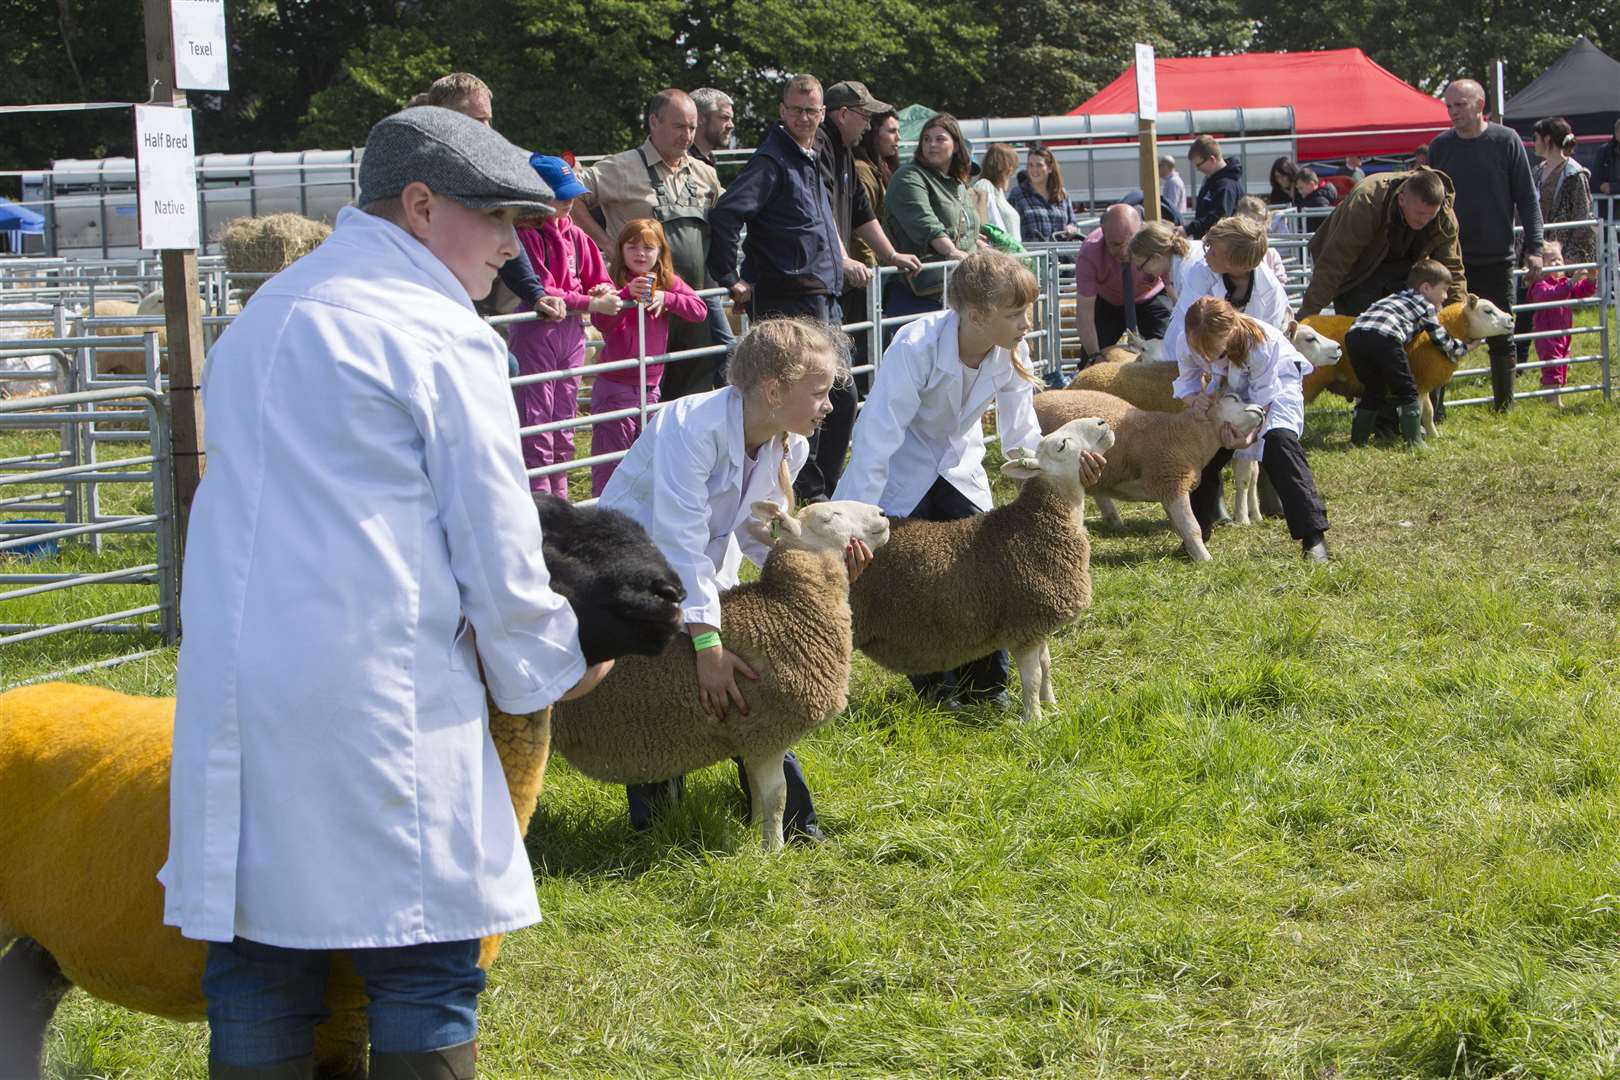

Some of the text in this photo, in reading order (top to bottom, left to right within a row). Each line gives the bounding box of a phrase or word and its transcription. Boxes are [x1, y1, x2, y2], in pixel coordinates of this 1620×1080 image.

[189, 41, 212, 56] Texel
[144, 132, 188, 148] Half Bred
[154, 199, 185, 215] Native
